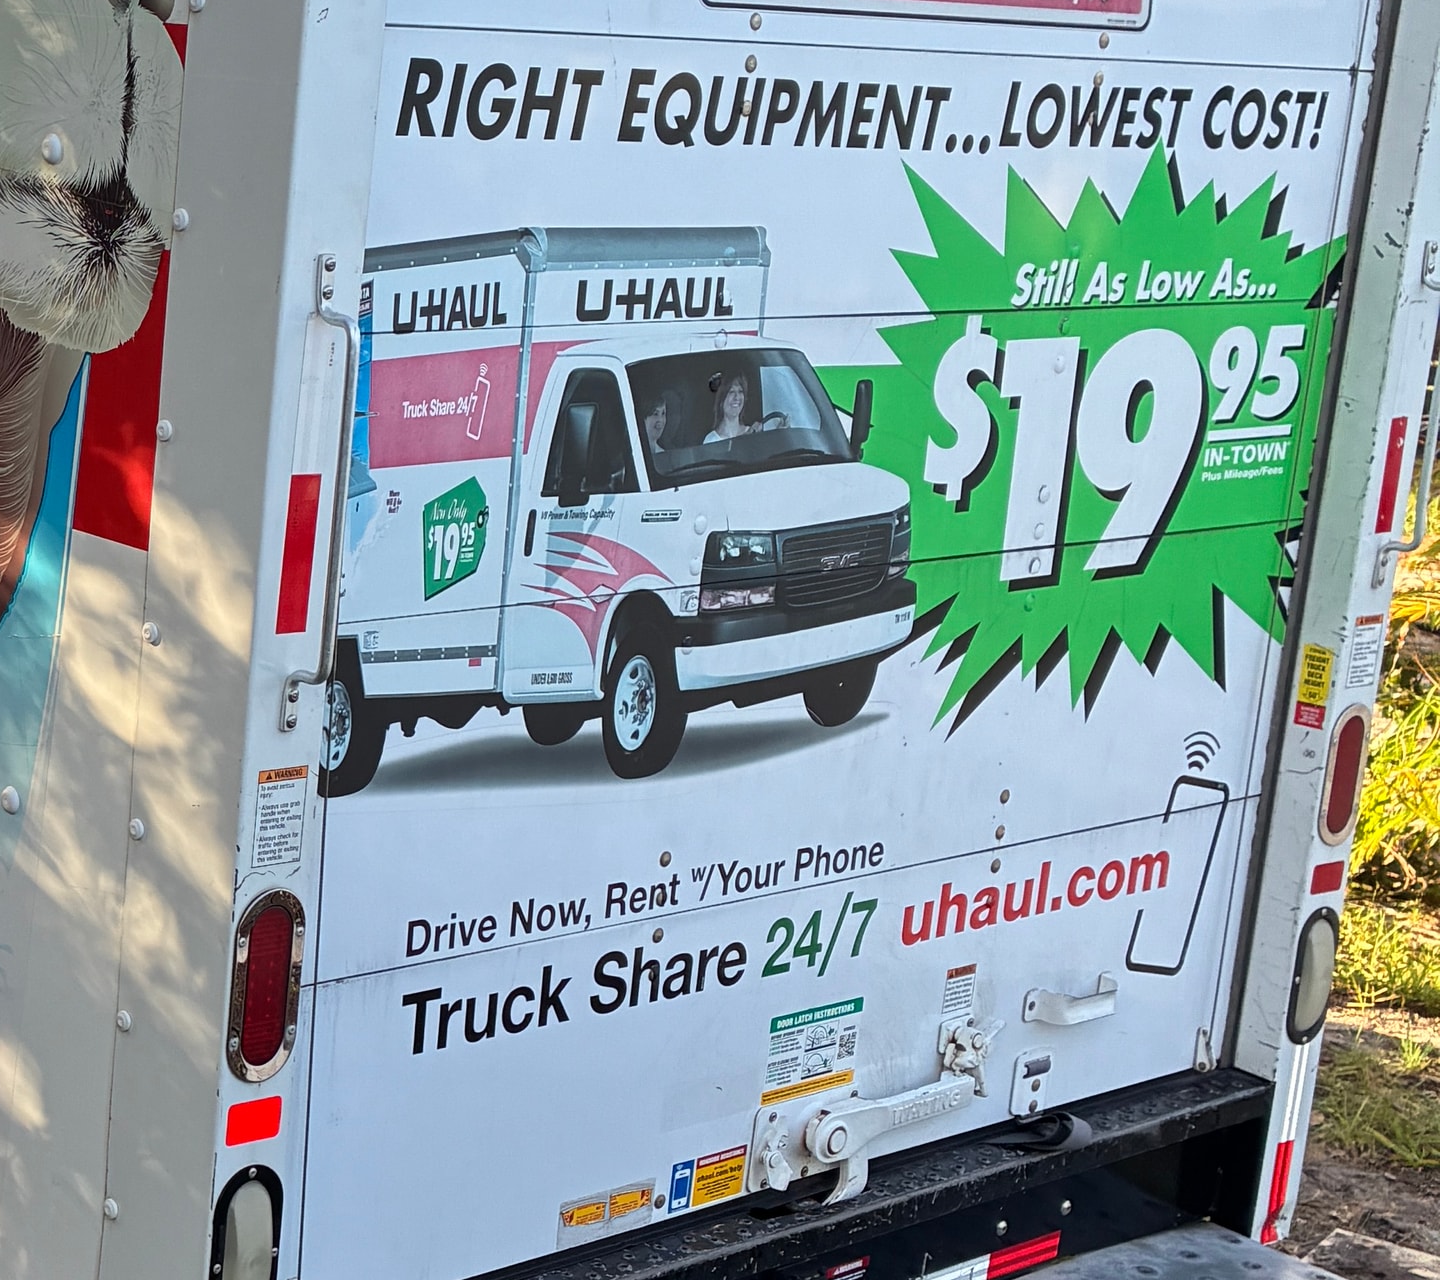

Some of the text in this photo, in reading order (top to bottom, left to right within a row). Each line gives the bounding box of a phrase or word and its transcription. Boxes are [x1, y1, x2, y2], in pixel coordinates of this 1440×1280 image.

[395, 57, 605, 141] RIGHT
[1202, 84, 1329, 152] COST!
[576, 276, 734, 322] U-HAUL
[1010, 258, 1278, 308] Still As Low As...
[393, 282, 508, 335] U-HAUL
[1210, 324, 1306, 420] 95
[402, 391, 478, 419] Truck Share 24/7
[1203, 441, 1289, 468] IN-TOWN
[1202, 465, 1284, 483] Plus Mileage/Fees
[431, 498, 468, 526] Now Only
[548, 510, 564, 521] Power
[568, 509, 589, 521] Towing
[589, 508, 616, 521] Capacity
[274, 768, 303, 780] WARNING
[405, 912, 497, 959] Drive
[509, 896, 594, 939] Now,
[604, 873, 681, 919] Rent
[794, 840, 885, 884] Phone
[402, 849, 1170, 1056] Truck Share 24/7 uhaul.com
[794, 1012, 813, 1025] LATCH
